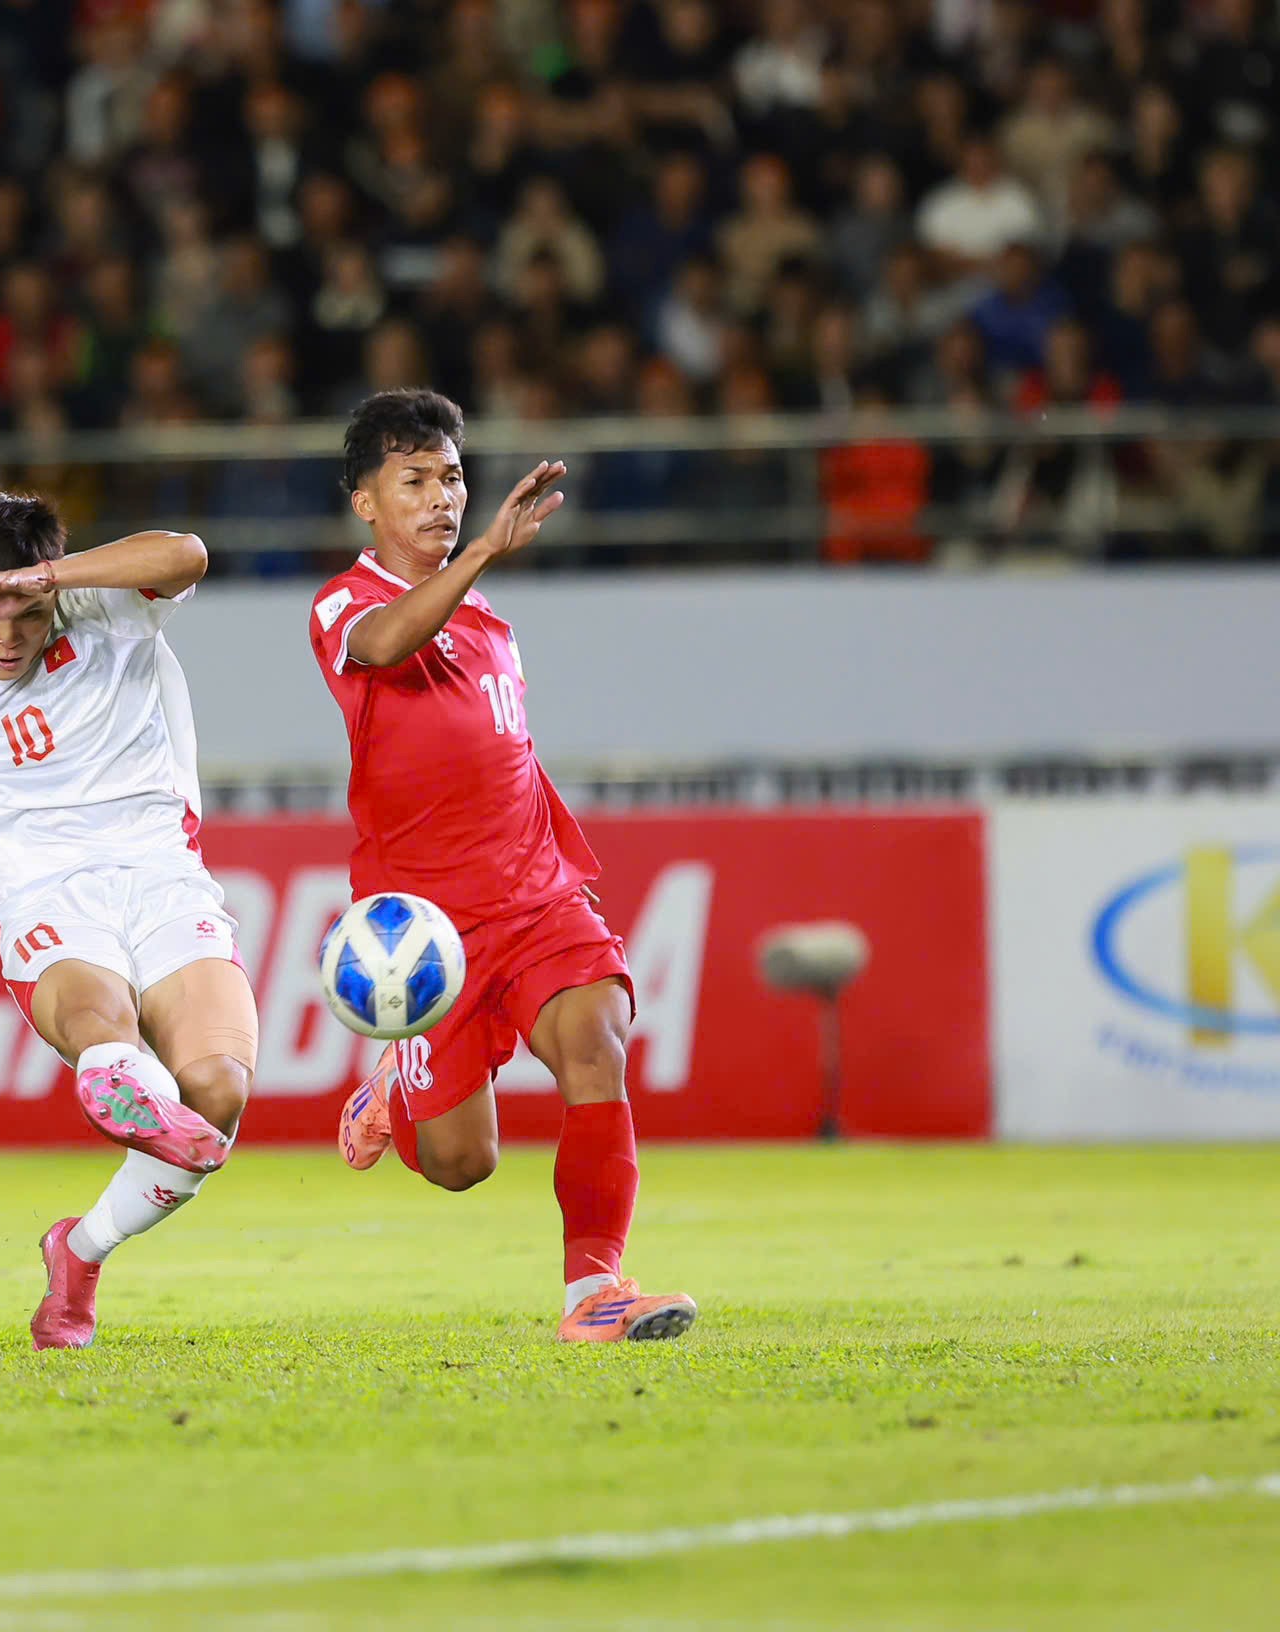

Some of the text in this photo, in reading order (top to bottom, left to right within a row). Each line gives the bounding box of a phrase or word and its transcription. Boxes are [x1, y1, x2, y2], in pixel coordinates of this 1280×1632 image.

[480, 673, 519, 734] 10
[1, 704, 56, 767] 10
[13, 922, 64, 963] 10
[399, 1034, 433, 1093] 10
